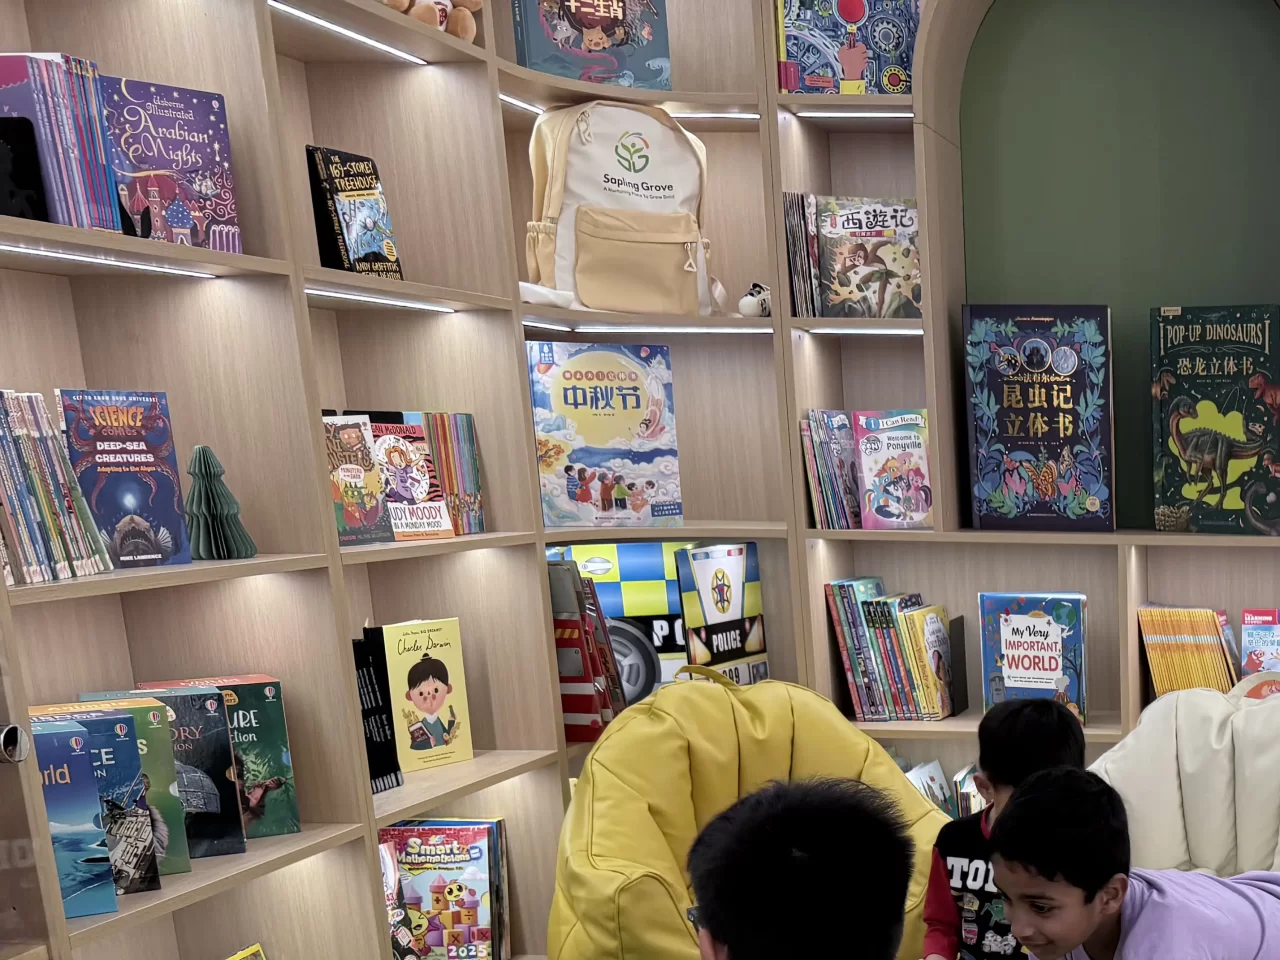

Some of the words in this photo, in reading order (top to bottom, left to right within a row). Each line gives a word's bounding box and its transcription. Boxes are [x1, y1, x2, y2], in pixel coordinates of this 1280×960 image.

[146, 102, 195, 120] Illustrated
[153, 95, 185, 109] Usborne
[123, 105, 209, 143] Arabian
[141, 133, 203, 170] Nights
[329, 161, 374, 178] 169-STOREY
[334, 175, 378, 191] TREEHOUSE
[603, 173, 640, 192] Sapling
[641, 182, 674, 191] Grove
[1165, 324, 1202, 347] POP-UP
[1205, 322, 1263, 346] DINOSAURS
[1177, 356, 1254, 376] 恐龙立体书
[562, 384, 642, 411] 中秋节
[1002, 383, 1074, 409] 昆虫记
[89, 405, 145, 427] SCIENCE
[1003, 412, 1074, 438] 立体书
[101, 428, 138, 436] COMICS
[96, 441, 148, 450] DEEP-SEA
[886, 440, 922, 451] Ponyville
[95, 454, 155, 463] CREATURES
[389, 506, 409, 521] UDY
[408, 505, 443, 520] MOODY
[712, 629, 742, 653] POLICE
[1011, 626, 1025, 639] My
[1025, 624, 1050, 640] Very
[397, 638, 422, 656] Charles
[425, 633, 452, 651] Darwin
[1005, 638, 1059, 652] IMPORTANT
[1006, 653, 1059, 672] WORLD
[407, 837, 459, 855] Smart
[396, 849, 471, 864] Mathematicians
[447, 944, 488, 957] 2025
